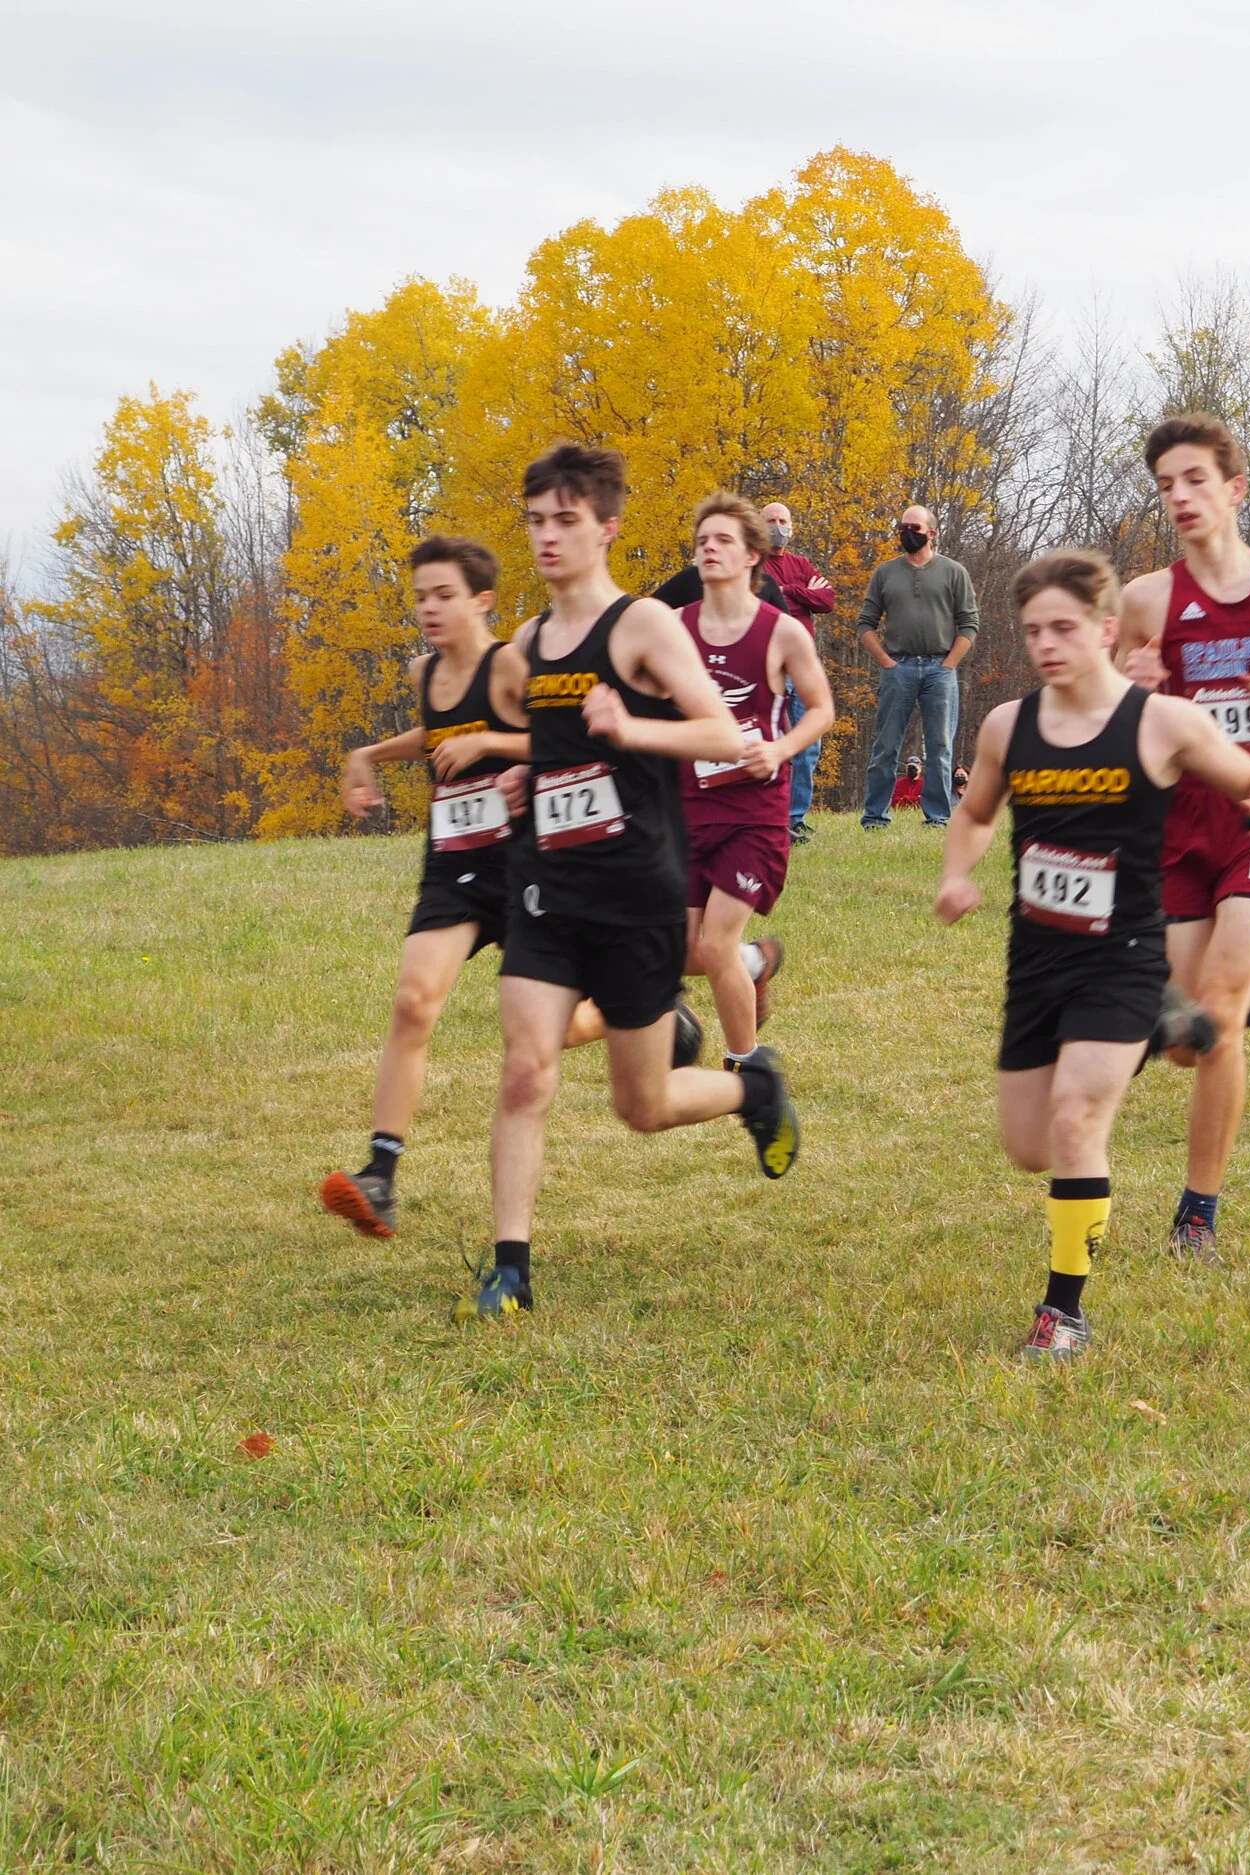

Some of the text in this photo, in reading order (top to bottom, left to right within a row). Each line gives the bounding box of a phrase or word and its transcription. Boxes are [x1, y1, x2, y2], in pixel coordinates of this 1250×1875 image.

[1009, 768, 1131, 794] HARWOOD
[548, 787, 600, 825] 472
[1031, 869, 1092, 907] 492
